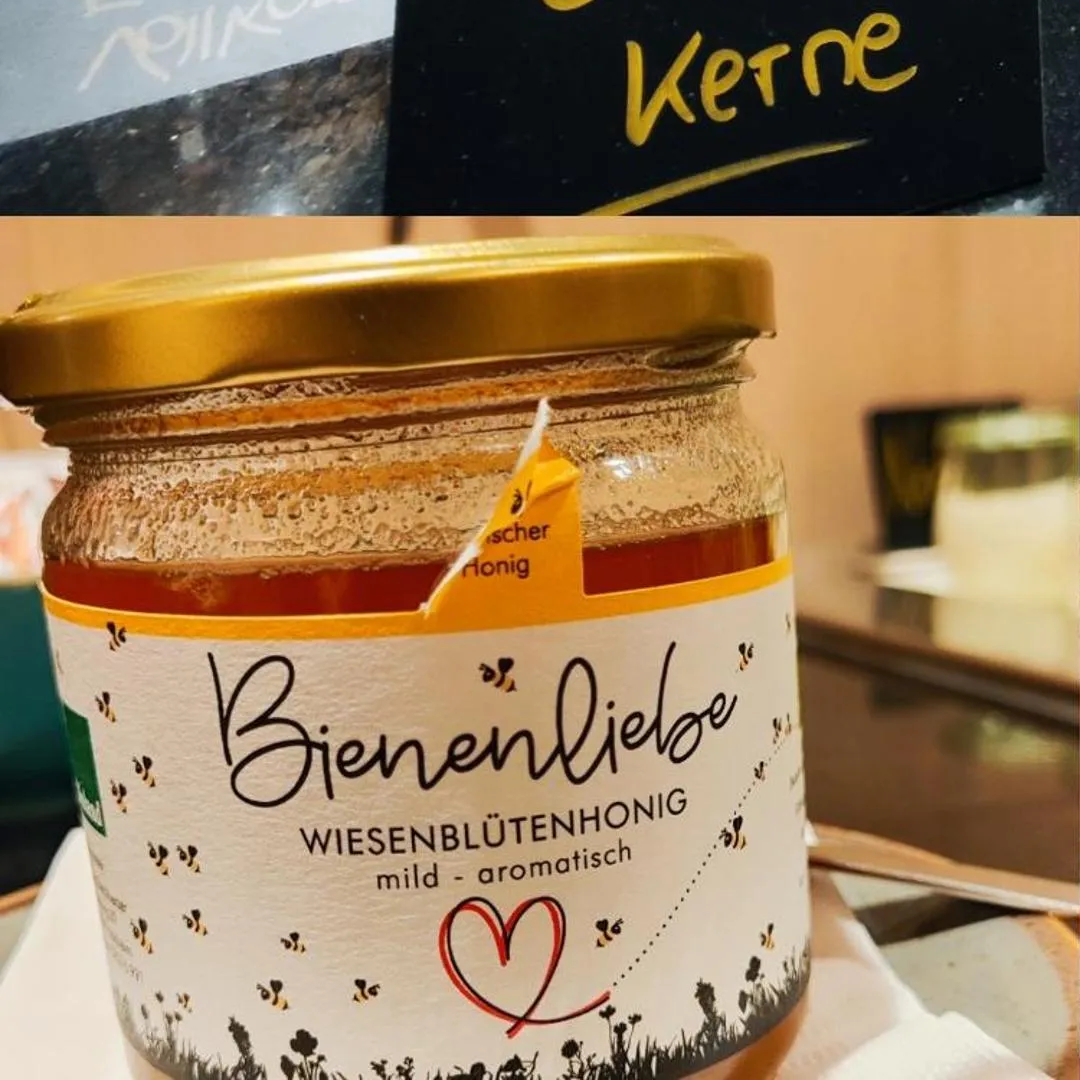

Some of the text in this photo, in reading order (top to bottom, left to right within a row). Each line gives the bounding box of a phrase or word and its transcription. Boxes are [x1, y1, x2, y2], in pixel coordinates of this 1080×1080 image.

[624, 11, 919, 147] Kerne
[461, 553, 531, 580] Honig
[206, 640, 739, 809] Bienenliebe
[299, 787, 689, 857] WIESENBLÜTENHONIG
[376, 864, 440, 891] mild
[477, 838, 633, 885] aromatisch
